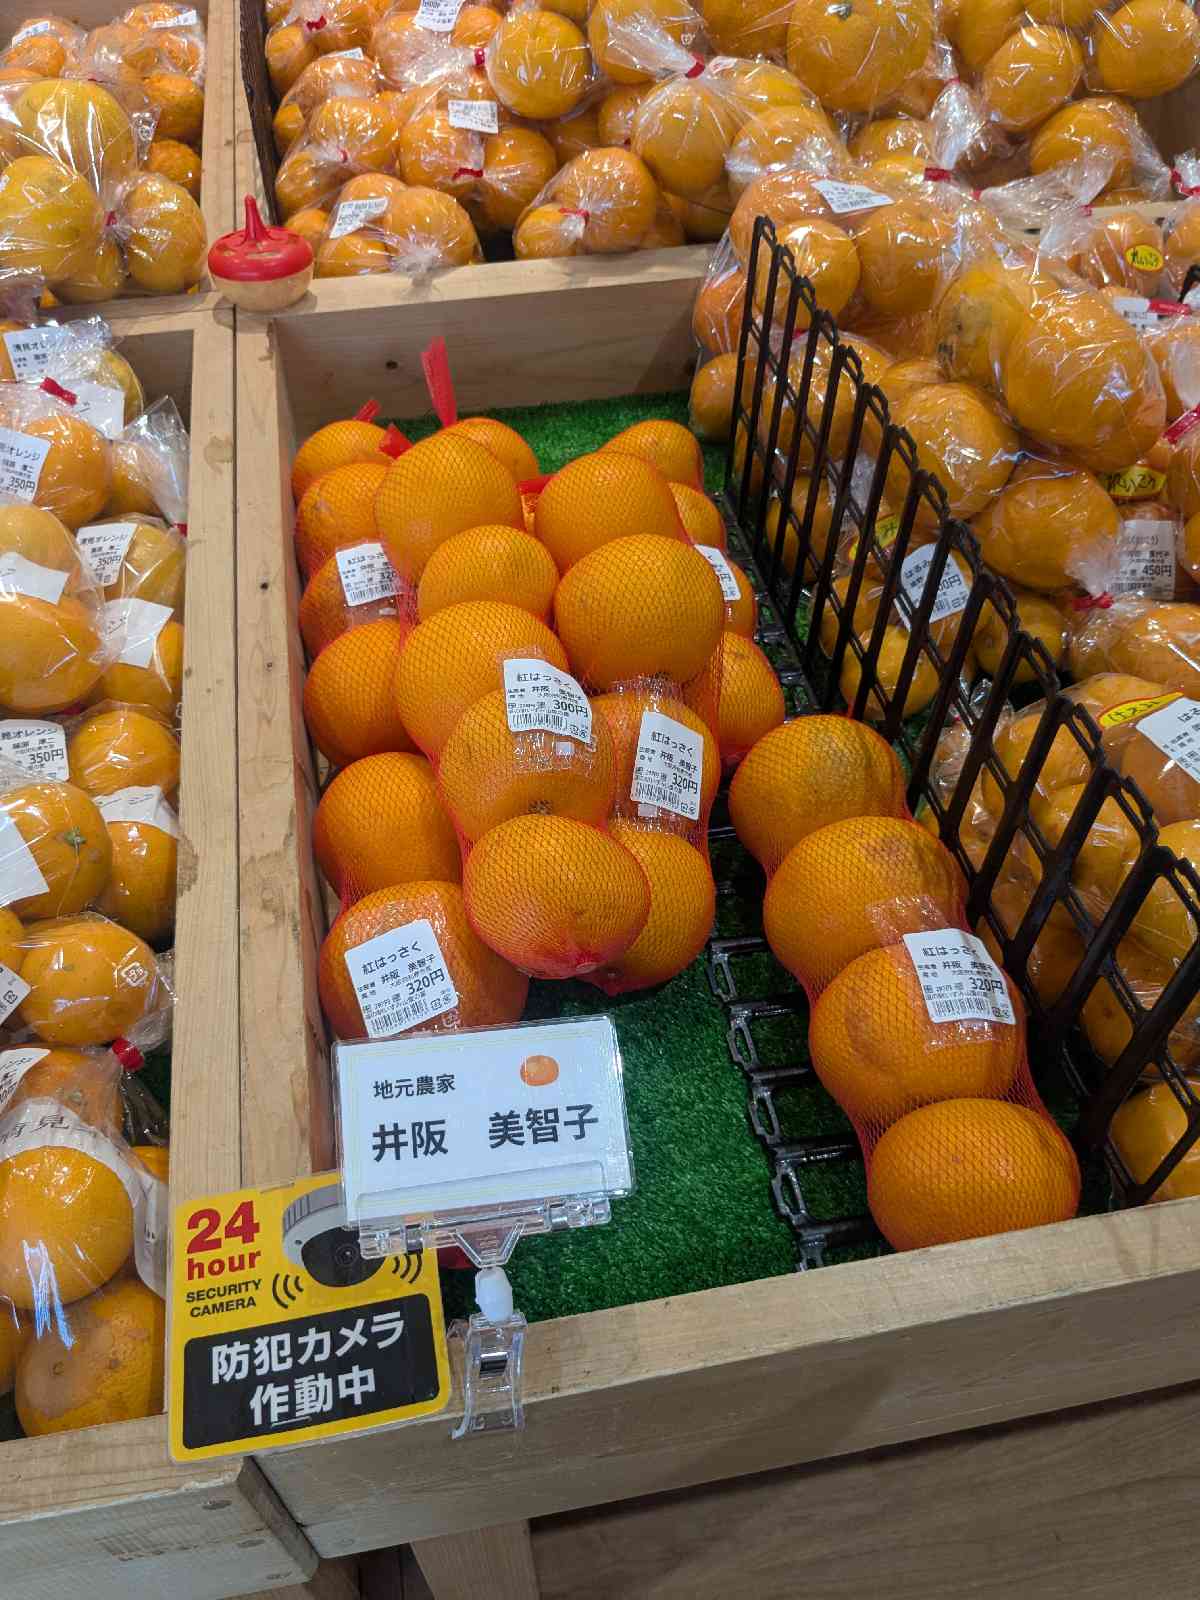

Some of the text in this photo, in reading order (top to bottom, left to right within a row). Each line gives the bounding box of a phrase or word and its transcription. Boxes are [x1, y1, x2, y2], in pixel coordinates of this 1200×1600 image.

[552, 699, 589, 718] 300円
[29, 747, 65, 765] 350円
[651, 731, 694, 758] 紅はっさく
[672, 772, 699, 795] 320円
[361, 940, 423, 976] 紅はっさく
[380, 968, 401, 985] 井阪
[405, 967, 446, 996] 320円
[968, 976, 1005, 995] 320円
[373, 1074, 456, 1100] 地元農家
[372, 1103, 600, 1163] 井阪 美智子
[186, 1200, 261, 1255] 24
[186, 1250, 262, 1281] hour
[186, 1279, 262, 1303] SECURITY
[189, 1296, 257, 1318] CAMERA
[211, 1310, 405, 1385] 防犯カメラ
[249, 1364, 376, 1426] 作動中
